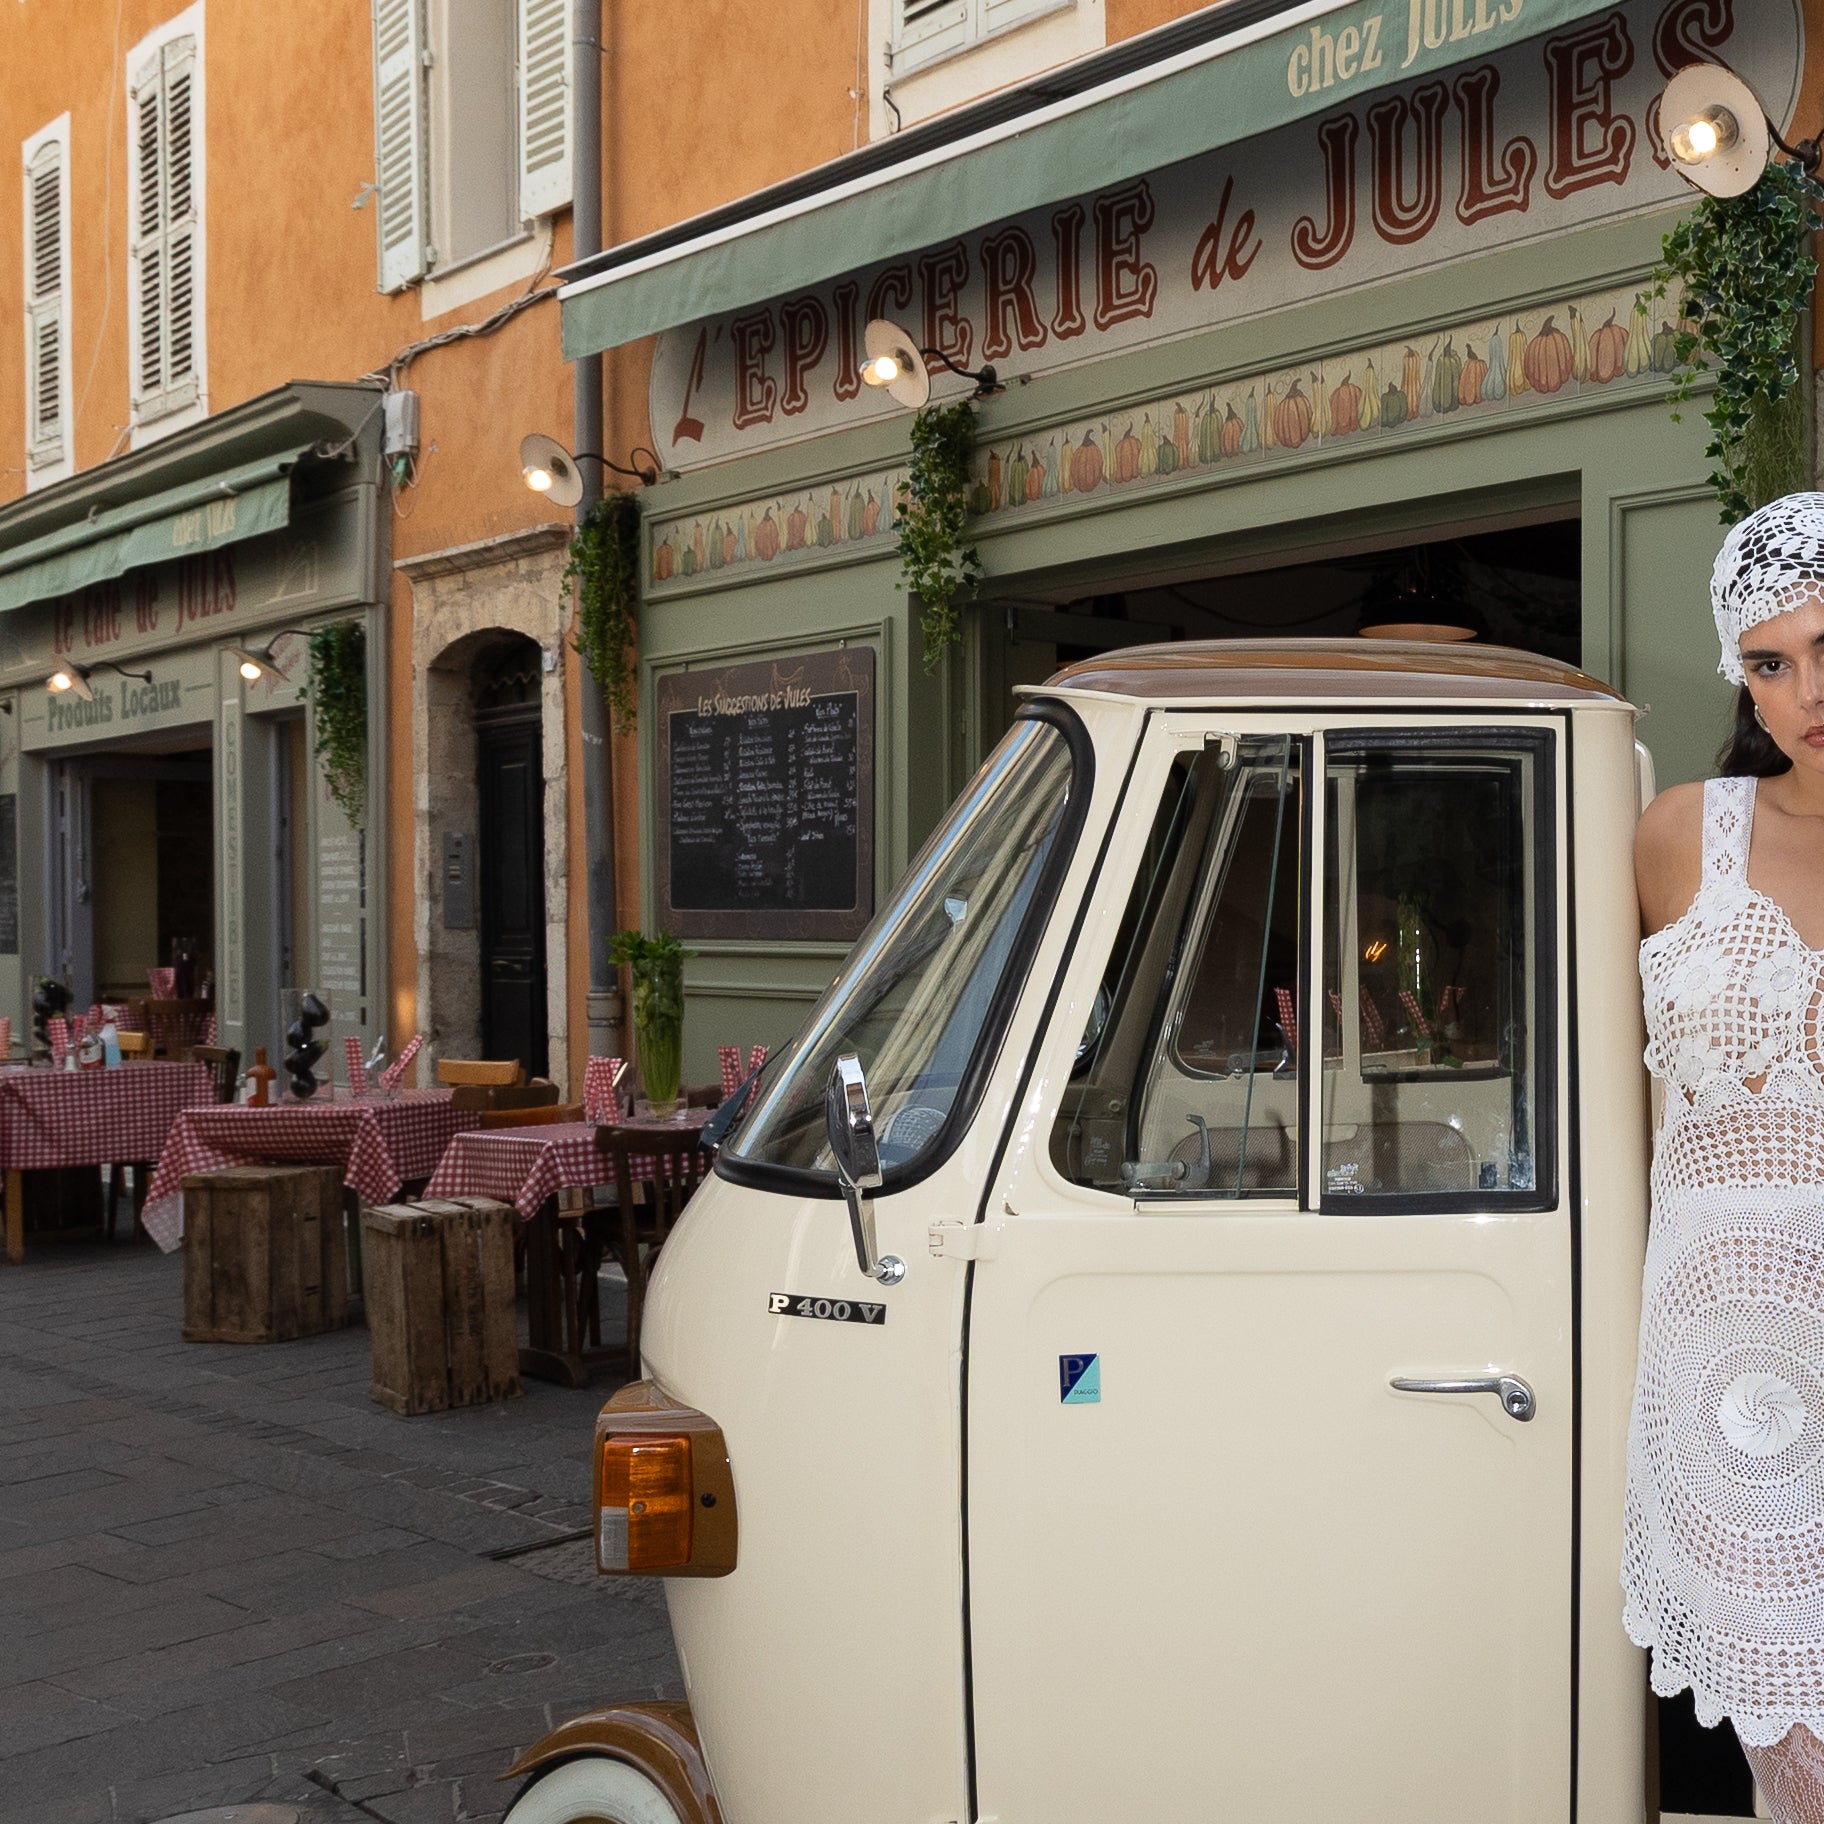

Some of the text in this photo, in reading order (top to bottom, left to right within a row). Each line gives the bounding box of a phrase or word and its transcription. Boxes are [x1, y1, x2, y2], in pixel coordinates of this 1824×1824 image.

[1287, 13, 1383, 98] chez
[1191, 176, 1263, 292] de
[47, 679, 181, 733] Produits Locaux
[769, 1294, 883, 1322] P 400 V
[1063, 1358, 1084, 1387] P
